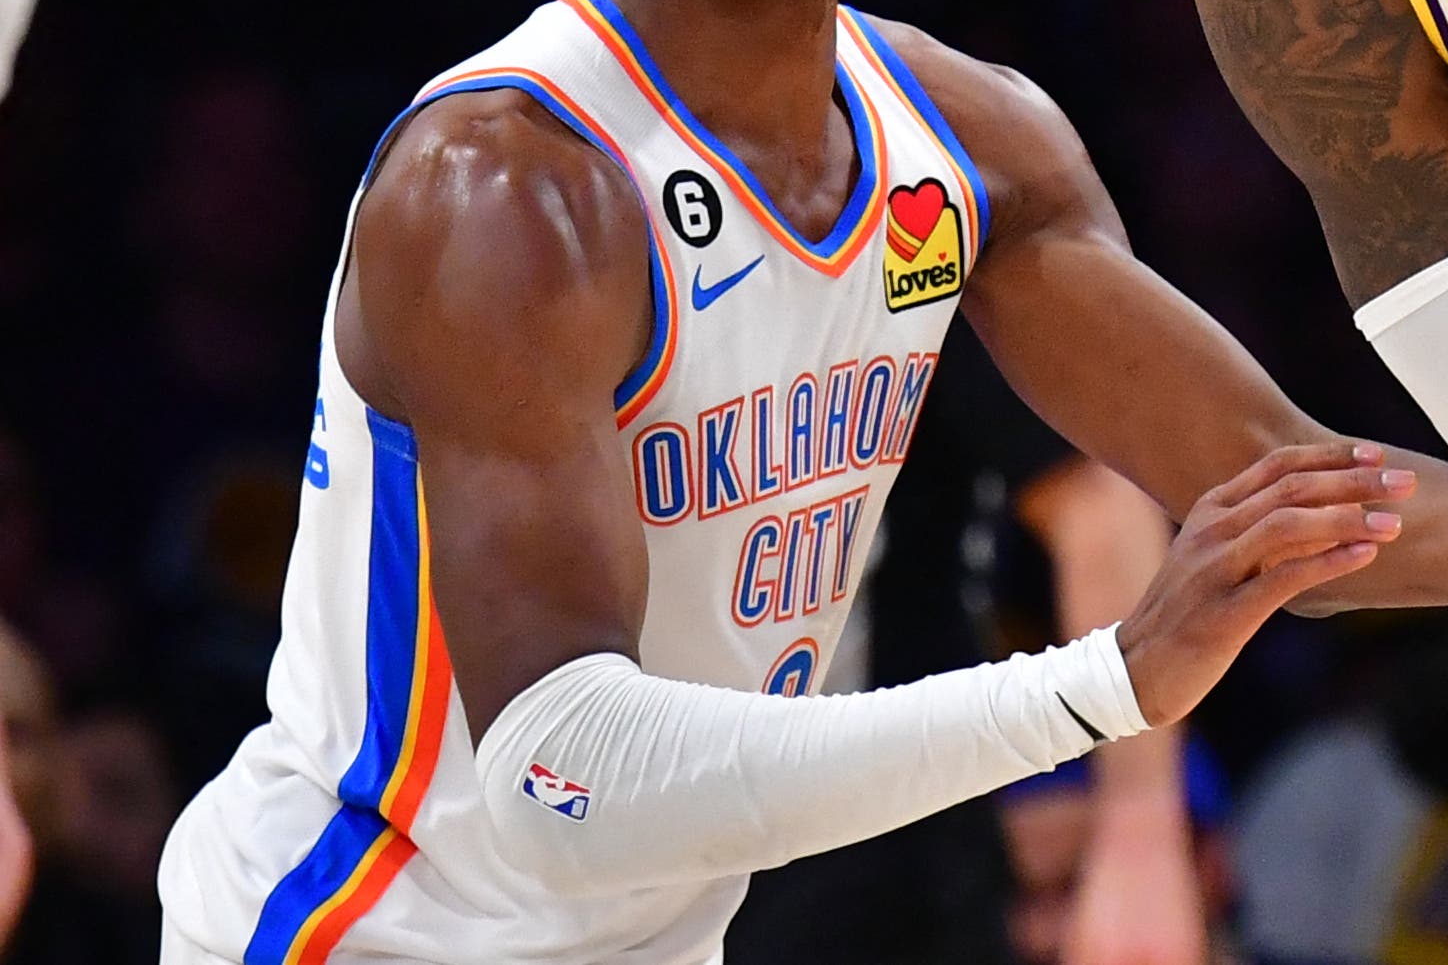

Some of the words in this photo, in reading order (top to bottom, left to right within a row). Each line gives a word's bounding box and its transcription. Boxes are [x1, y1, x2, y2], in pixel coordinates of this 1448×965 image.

[673, 181, 710, 241] 6
[632, 352, 939, 528] OKLAHOM
[731, 484, 870, 628] CITY
